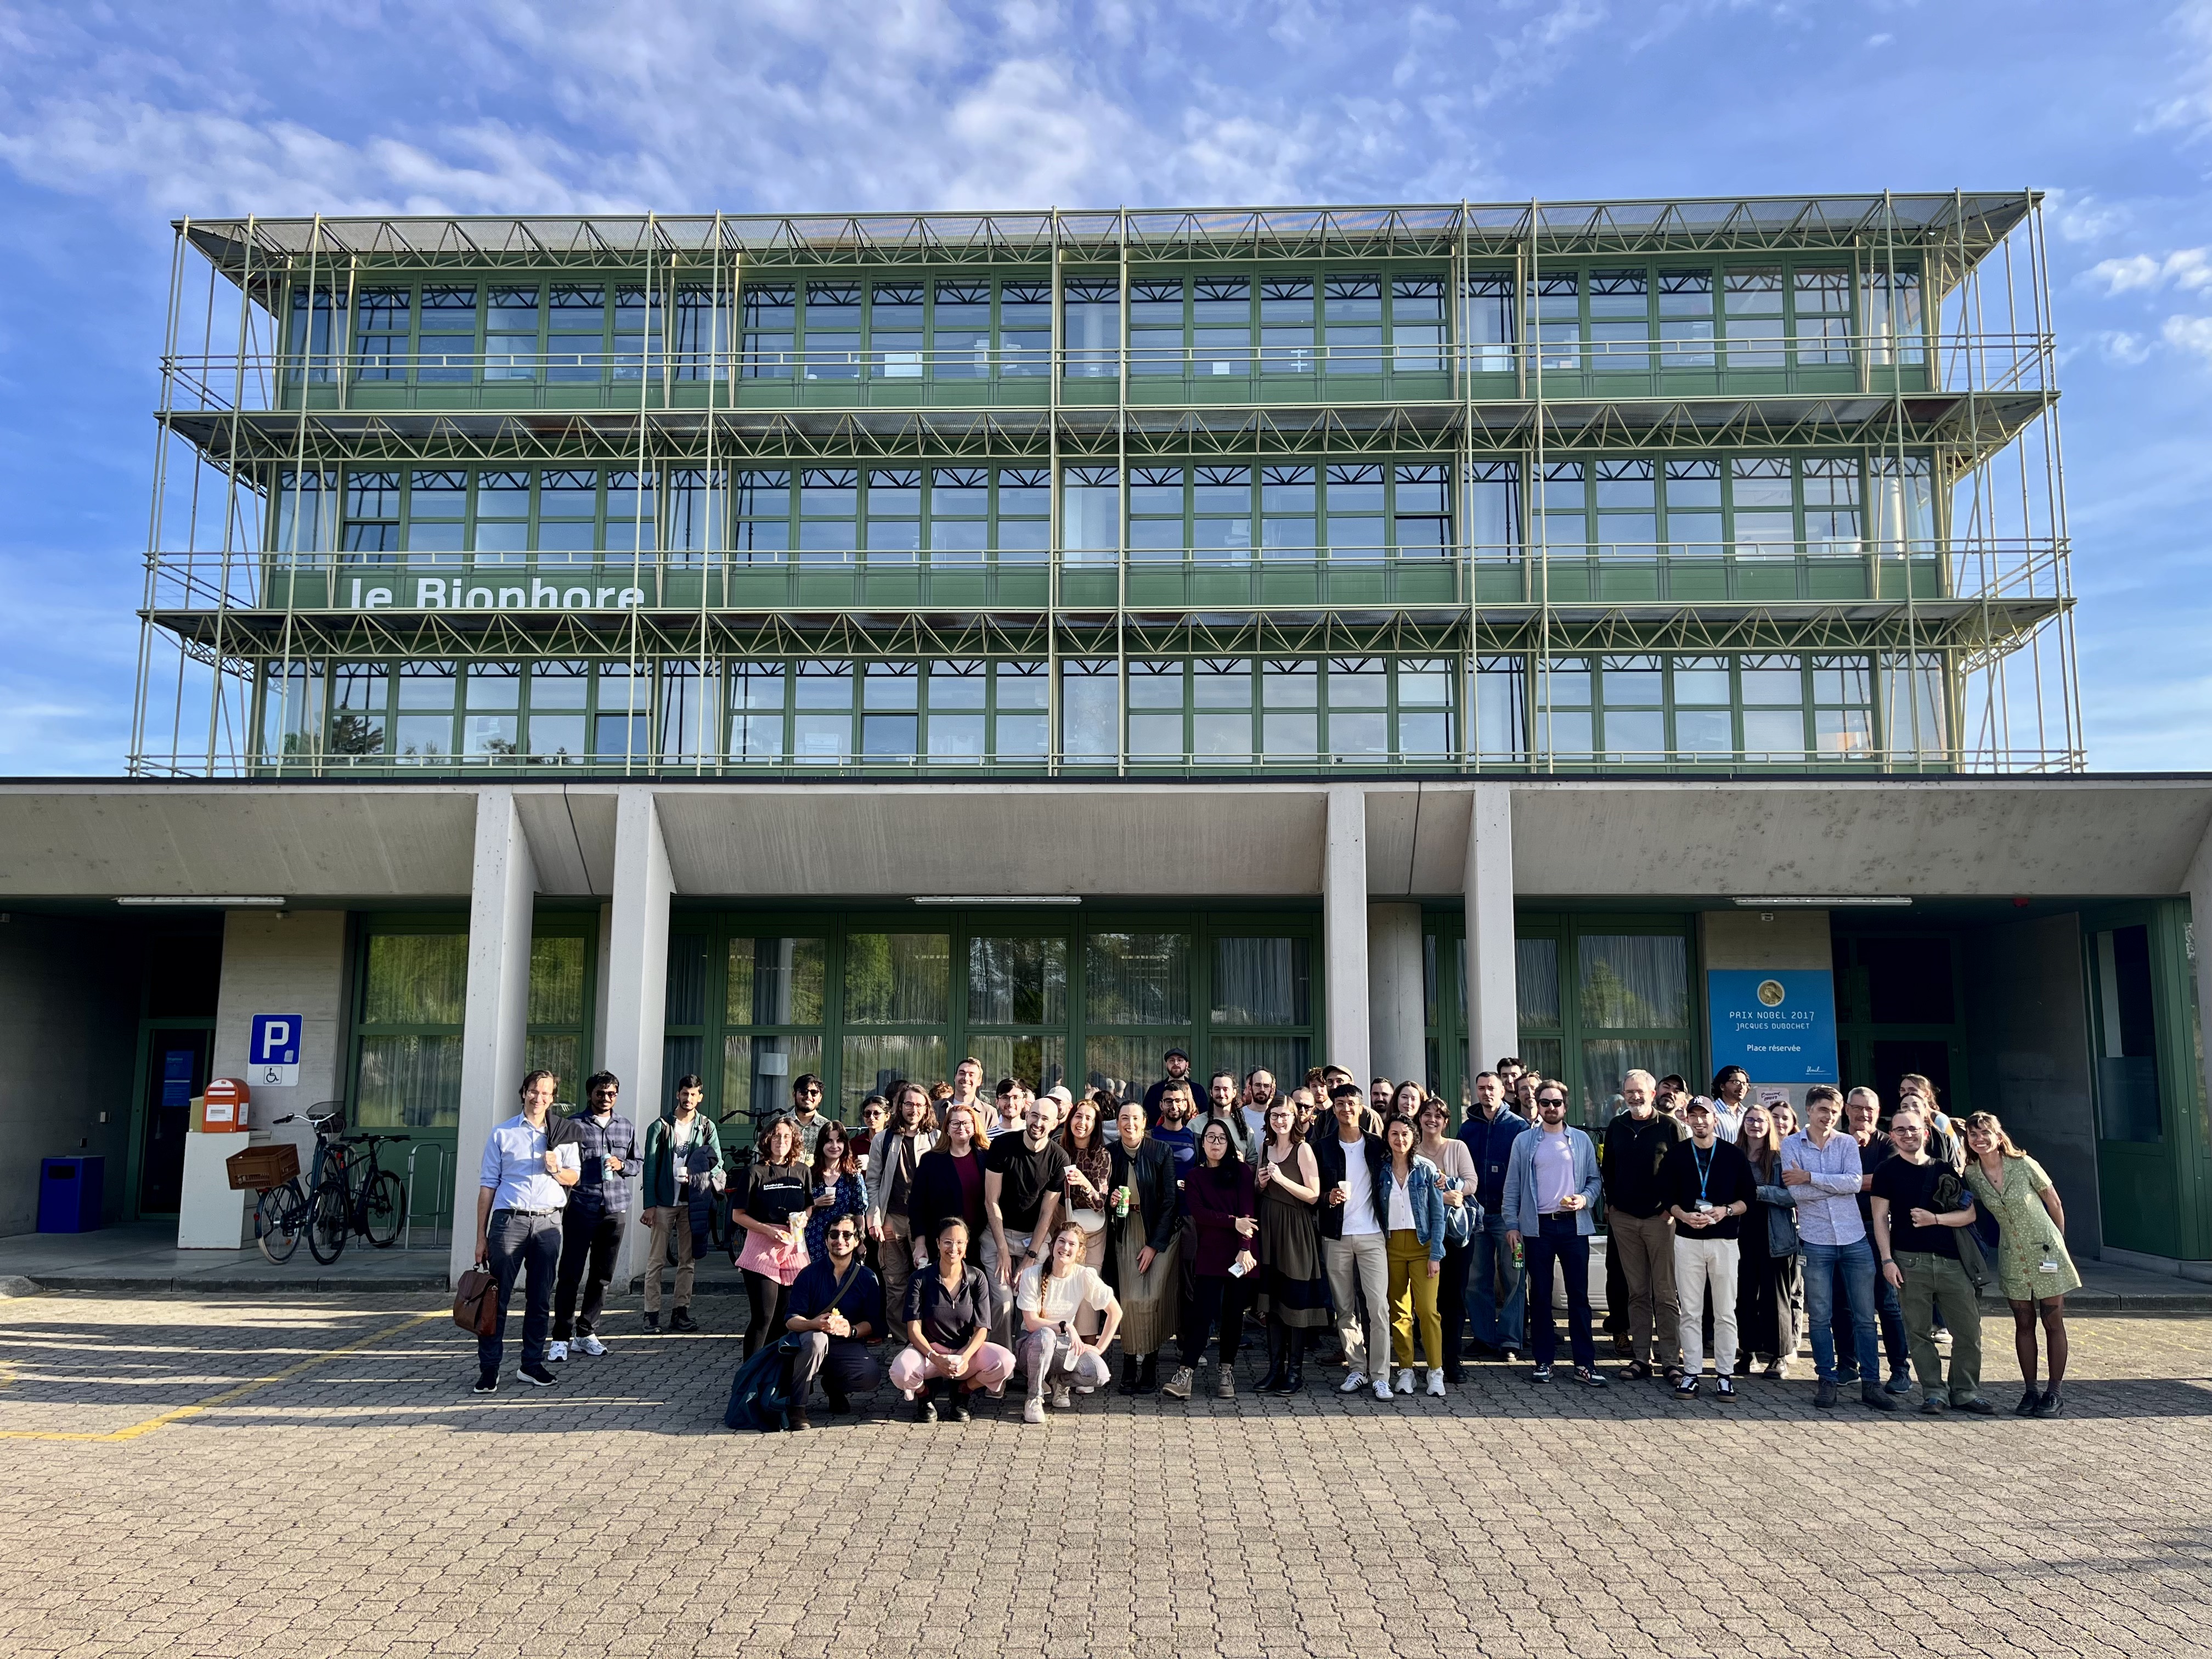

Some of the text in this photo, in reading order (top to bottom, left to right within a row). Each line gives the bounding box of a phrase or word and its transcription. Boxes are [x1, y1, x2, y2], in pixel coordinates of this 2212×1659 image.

[351, 578, 392, 608] le
[1729, 1011, 1814, 1022] PRIX NOBEL 2017
[263, 1021, 289, 1059] P
